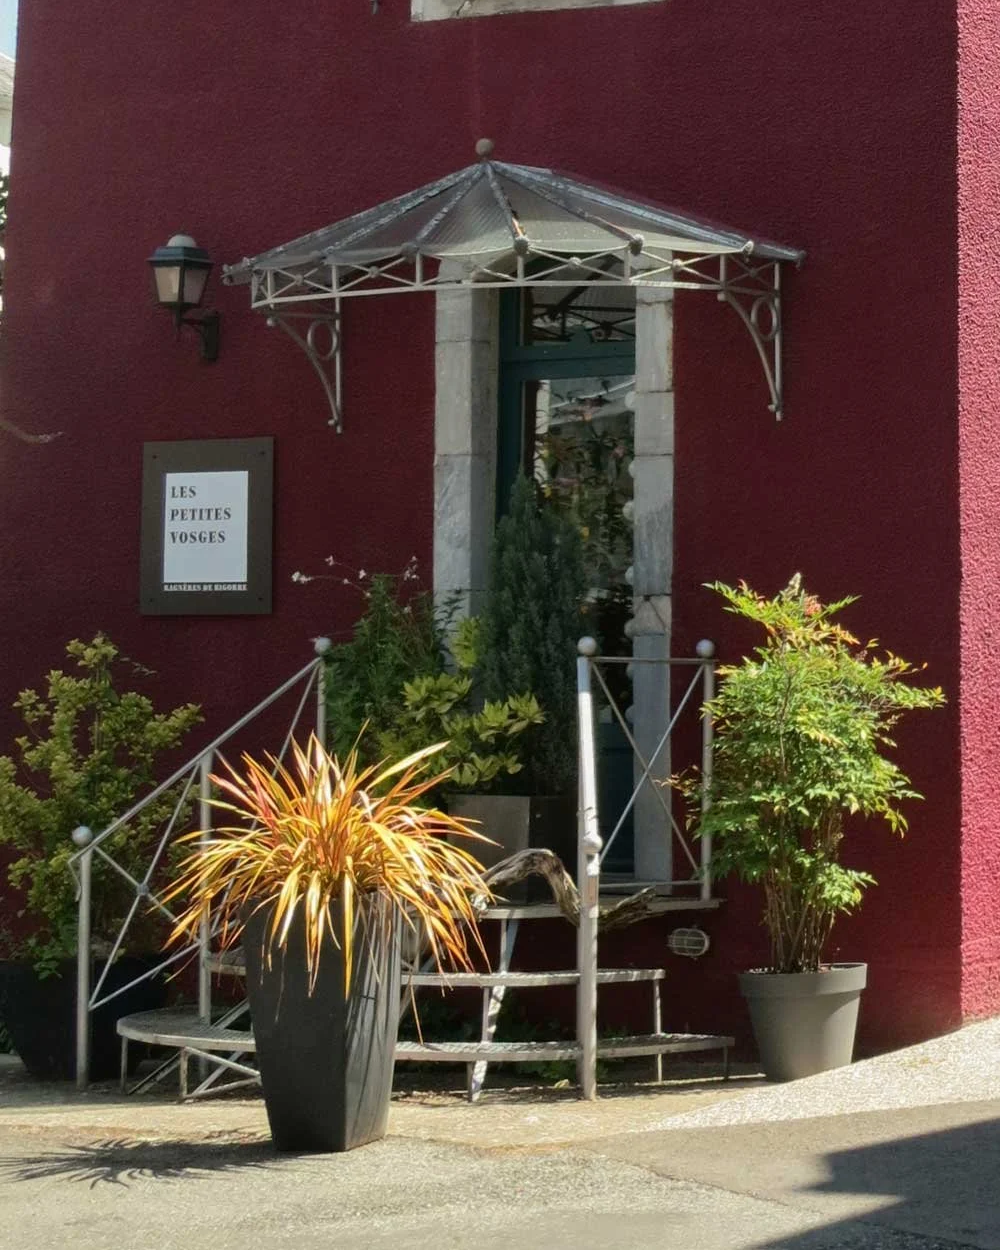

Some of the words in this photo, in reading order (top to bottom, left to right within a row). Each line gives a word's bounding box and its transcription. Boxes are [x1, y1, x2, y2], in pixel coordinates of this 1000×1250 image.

[170, 486, 197, 498] LES
[170, 507, 232, 521] PETITES
[170, 531, 226, 544] VOSGES
